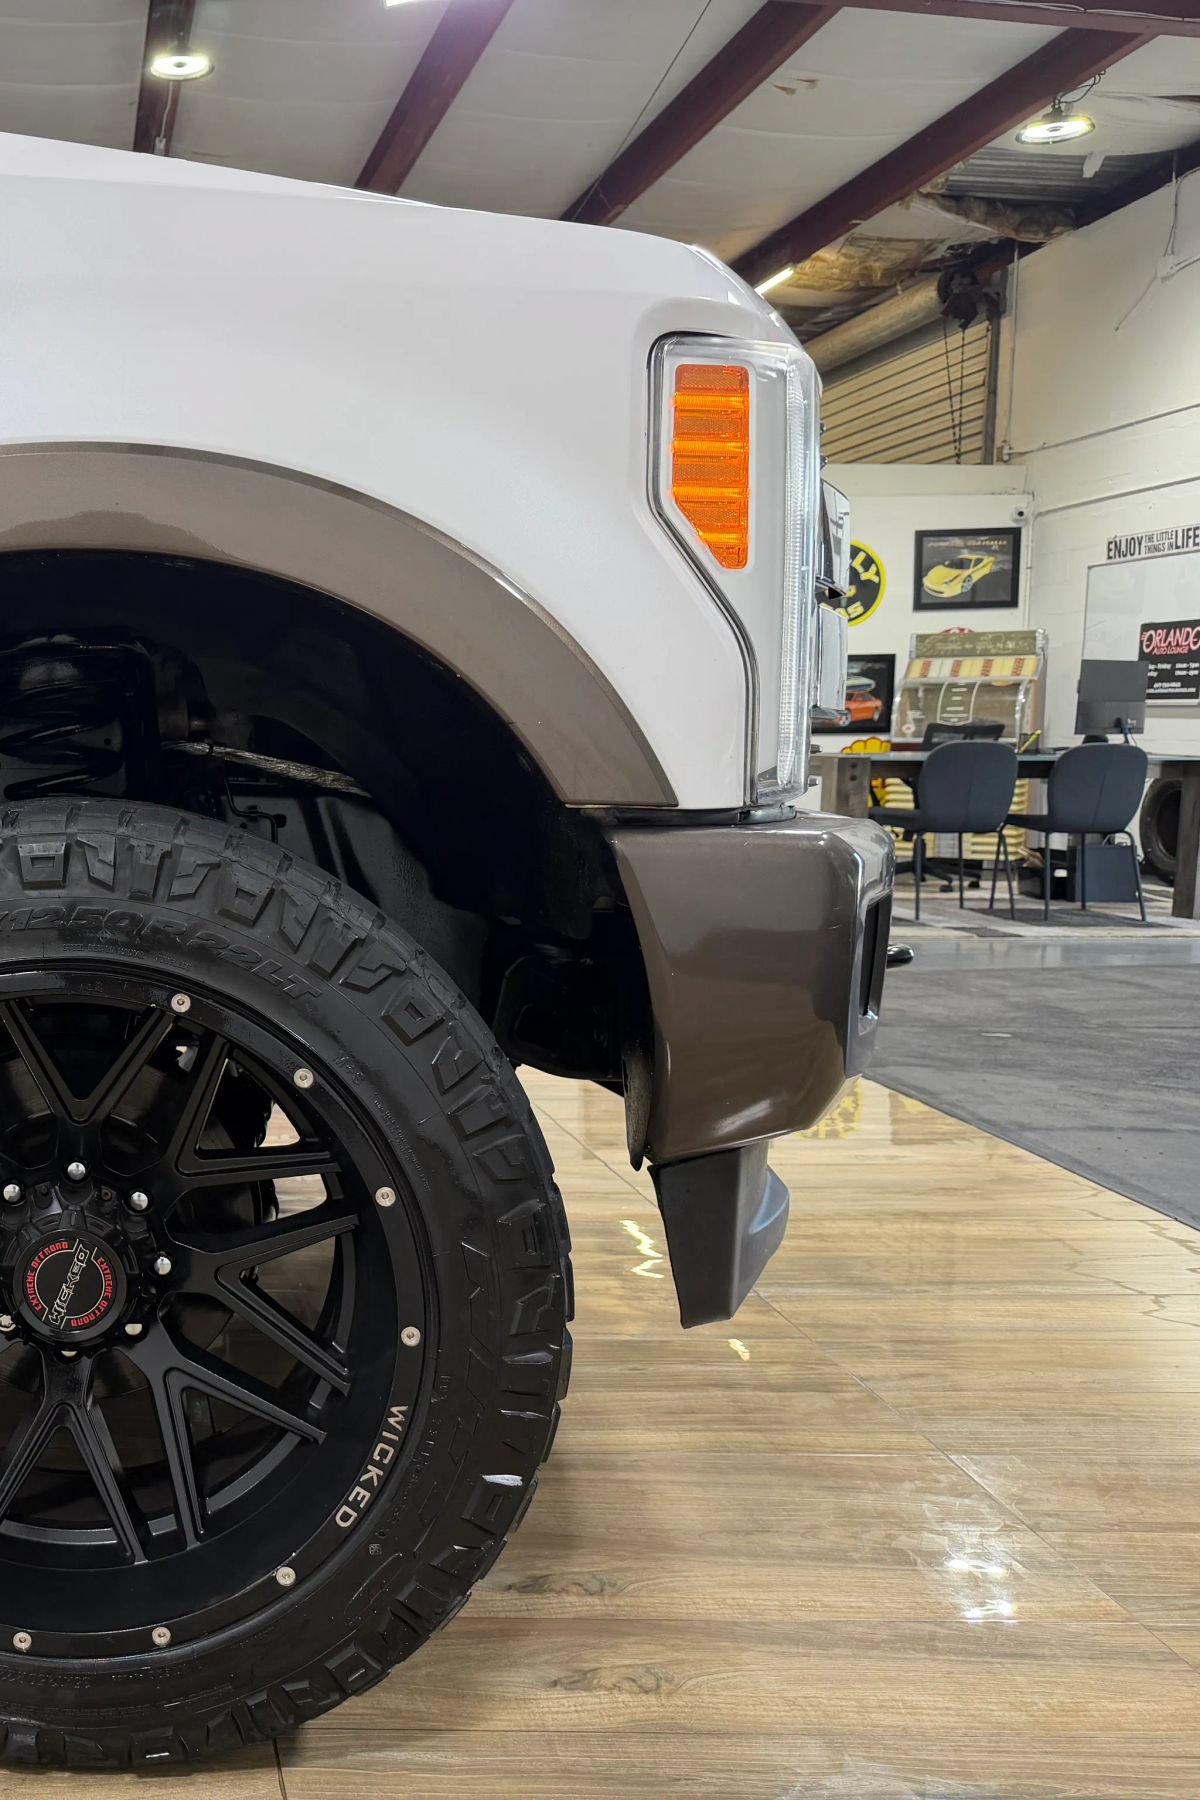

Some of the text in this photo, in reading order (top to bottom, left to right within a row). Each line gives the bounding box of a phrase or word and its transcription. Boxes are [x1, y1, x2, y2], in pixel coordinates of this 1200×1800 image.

[1144, 530, 1174, 543] THE LITTLE
[1175, 526, 1200, 549] LIFE
[1107, 536, 1144, 560] ENJOY
[1144, 541, 1174, 555] THINGS IN
[1152, 645, 1189, 656] AUTO LOUNGE
[335, 1405, 409, 1528] WICKED
